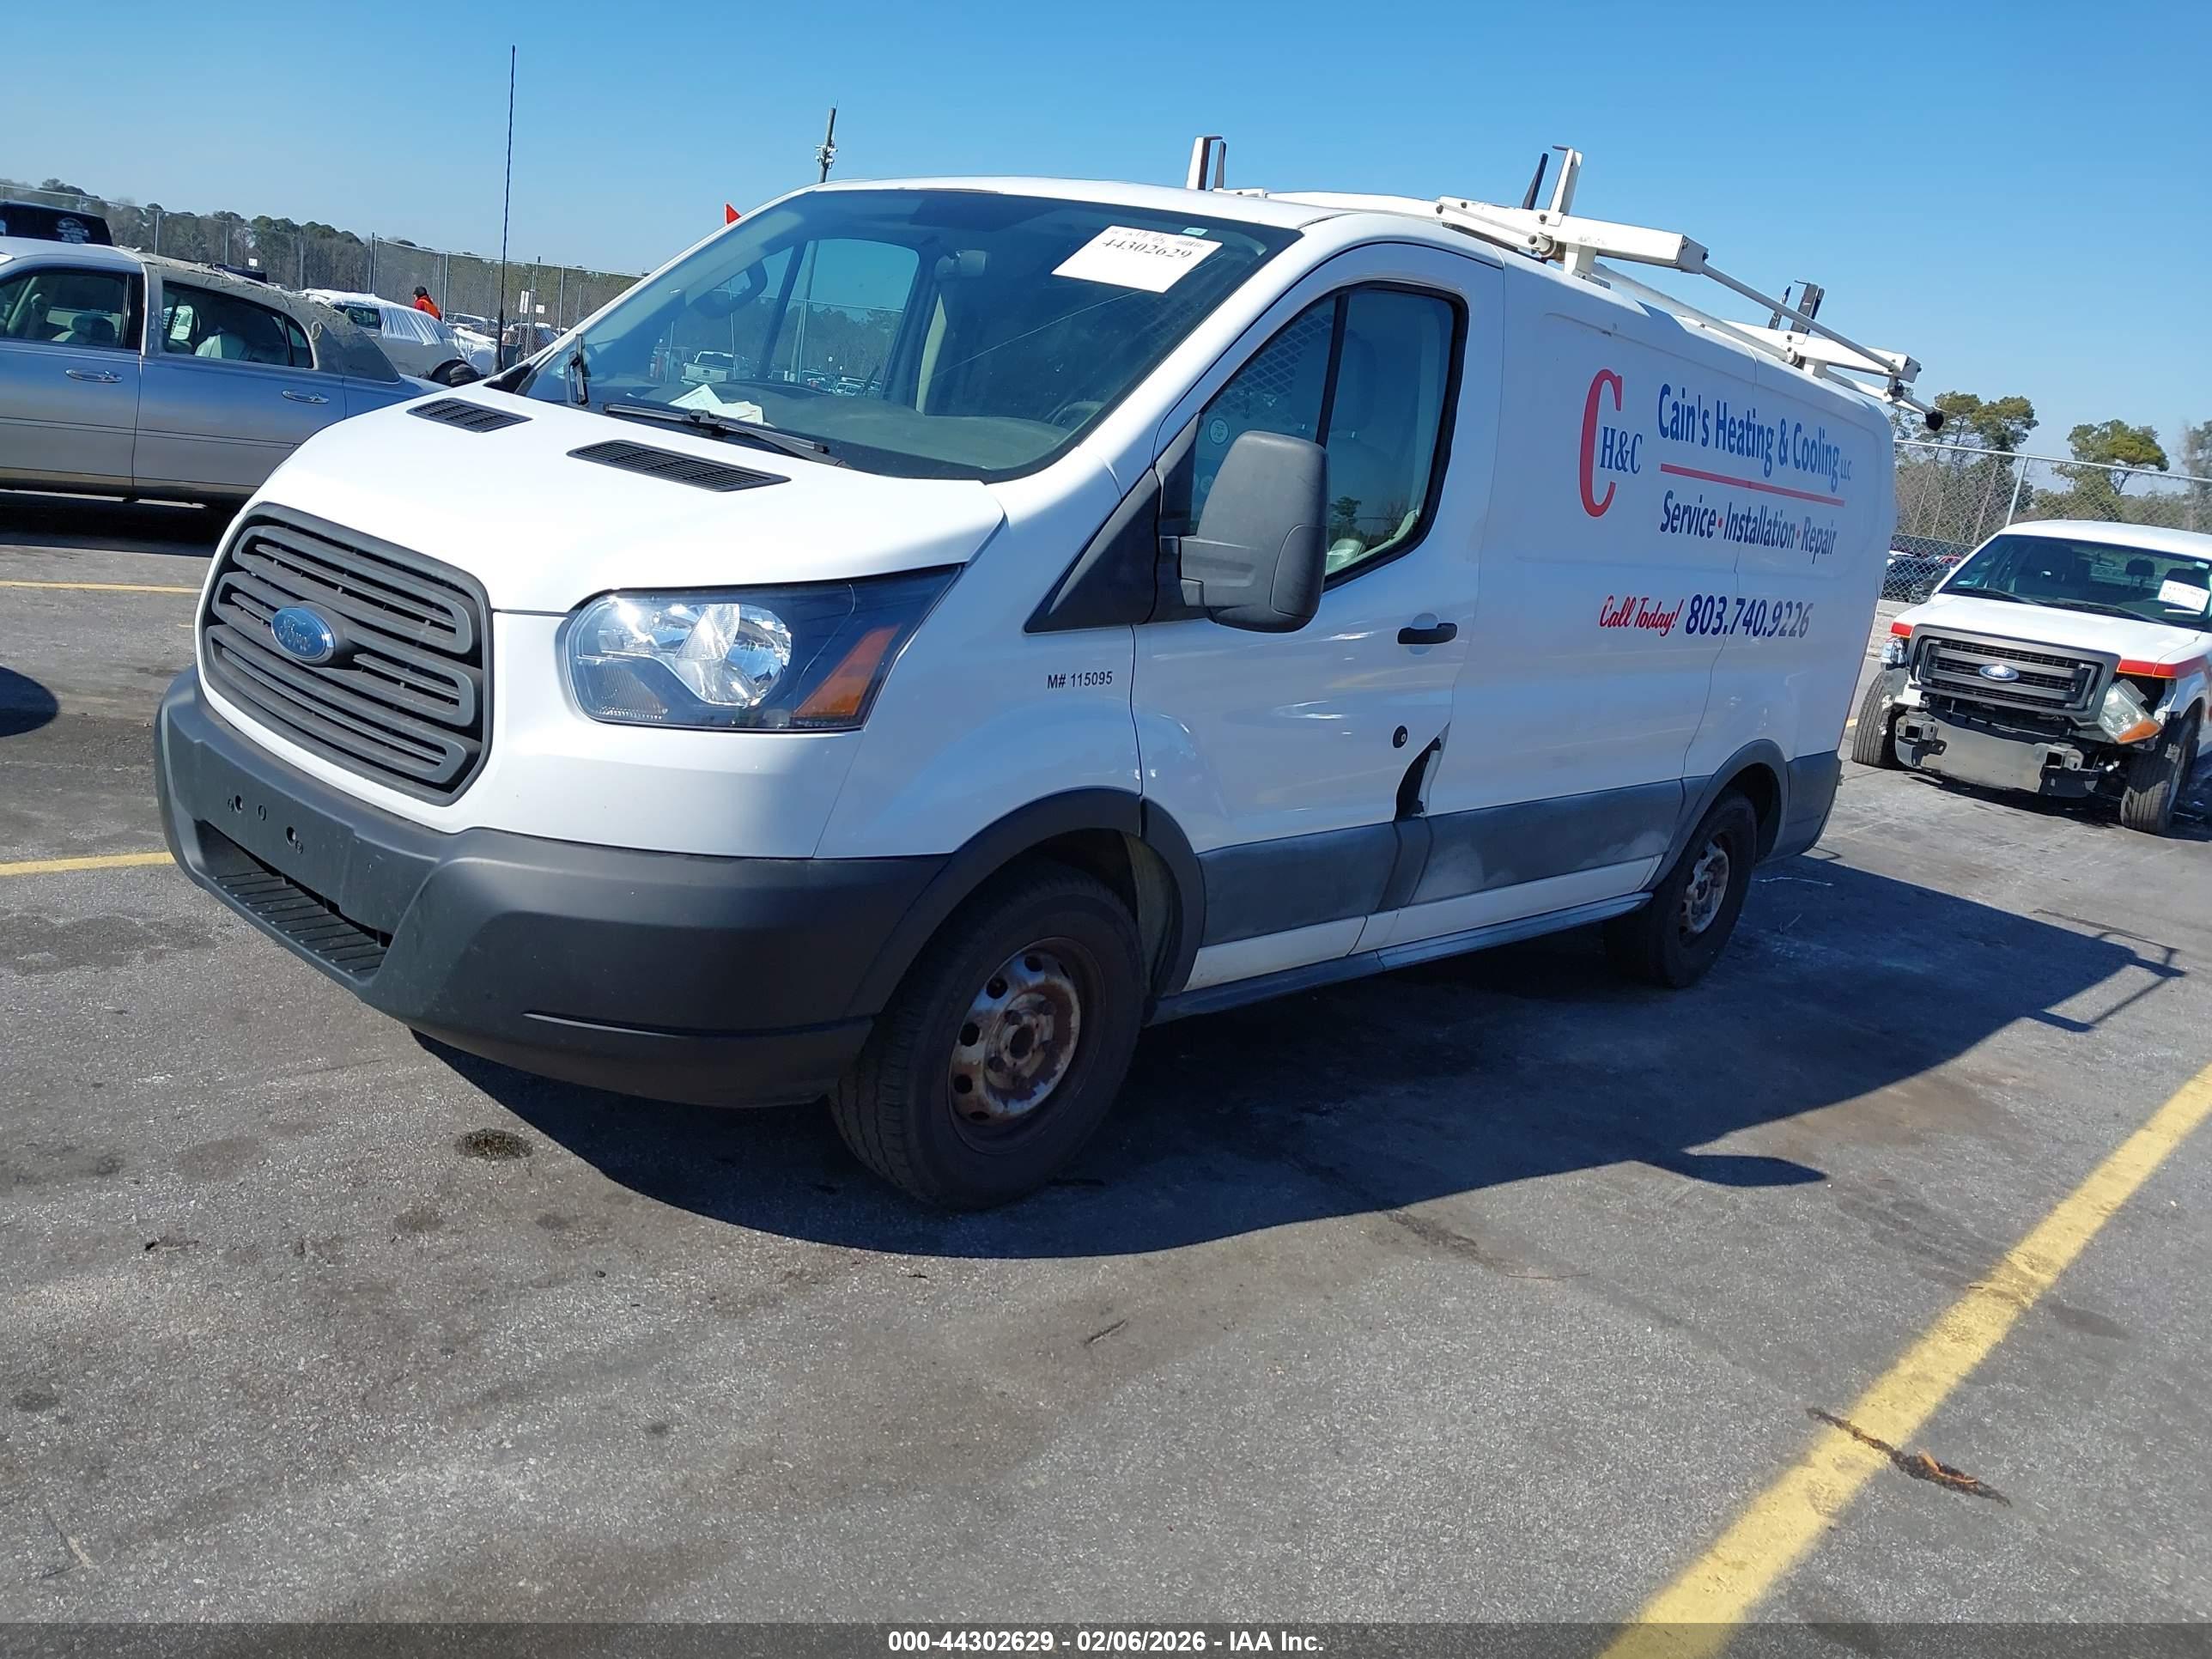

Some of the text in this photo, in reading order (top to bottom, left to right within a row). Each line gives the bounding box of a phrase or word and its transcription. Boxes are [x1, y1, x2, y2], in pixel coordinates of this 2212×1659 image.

[1102, 239, 1194, 258] 44302629
[1579, 368, 1623, 518] C
[1600, 426, 1643, 475] H&C
[1658, 383, 1852, 494] Cain's Heating & Cooling LLC
[1660, 489, 1837, 565] Service Installation Repair
[1599, 593, 1814, 638] Call Today! 803.740.9226
[1047, 670, 1114, 690] M# 115095
